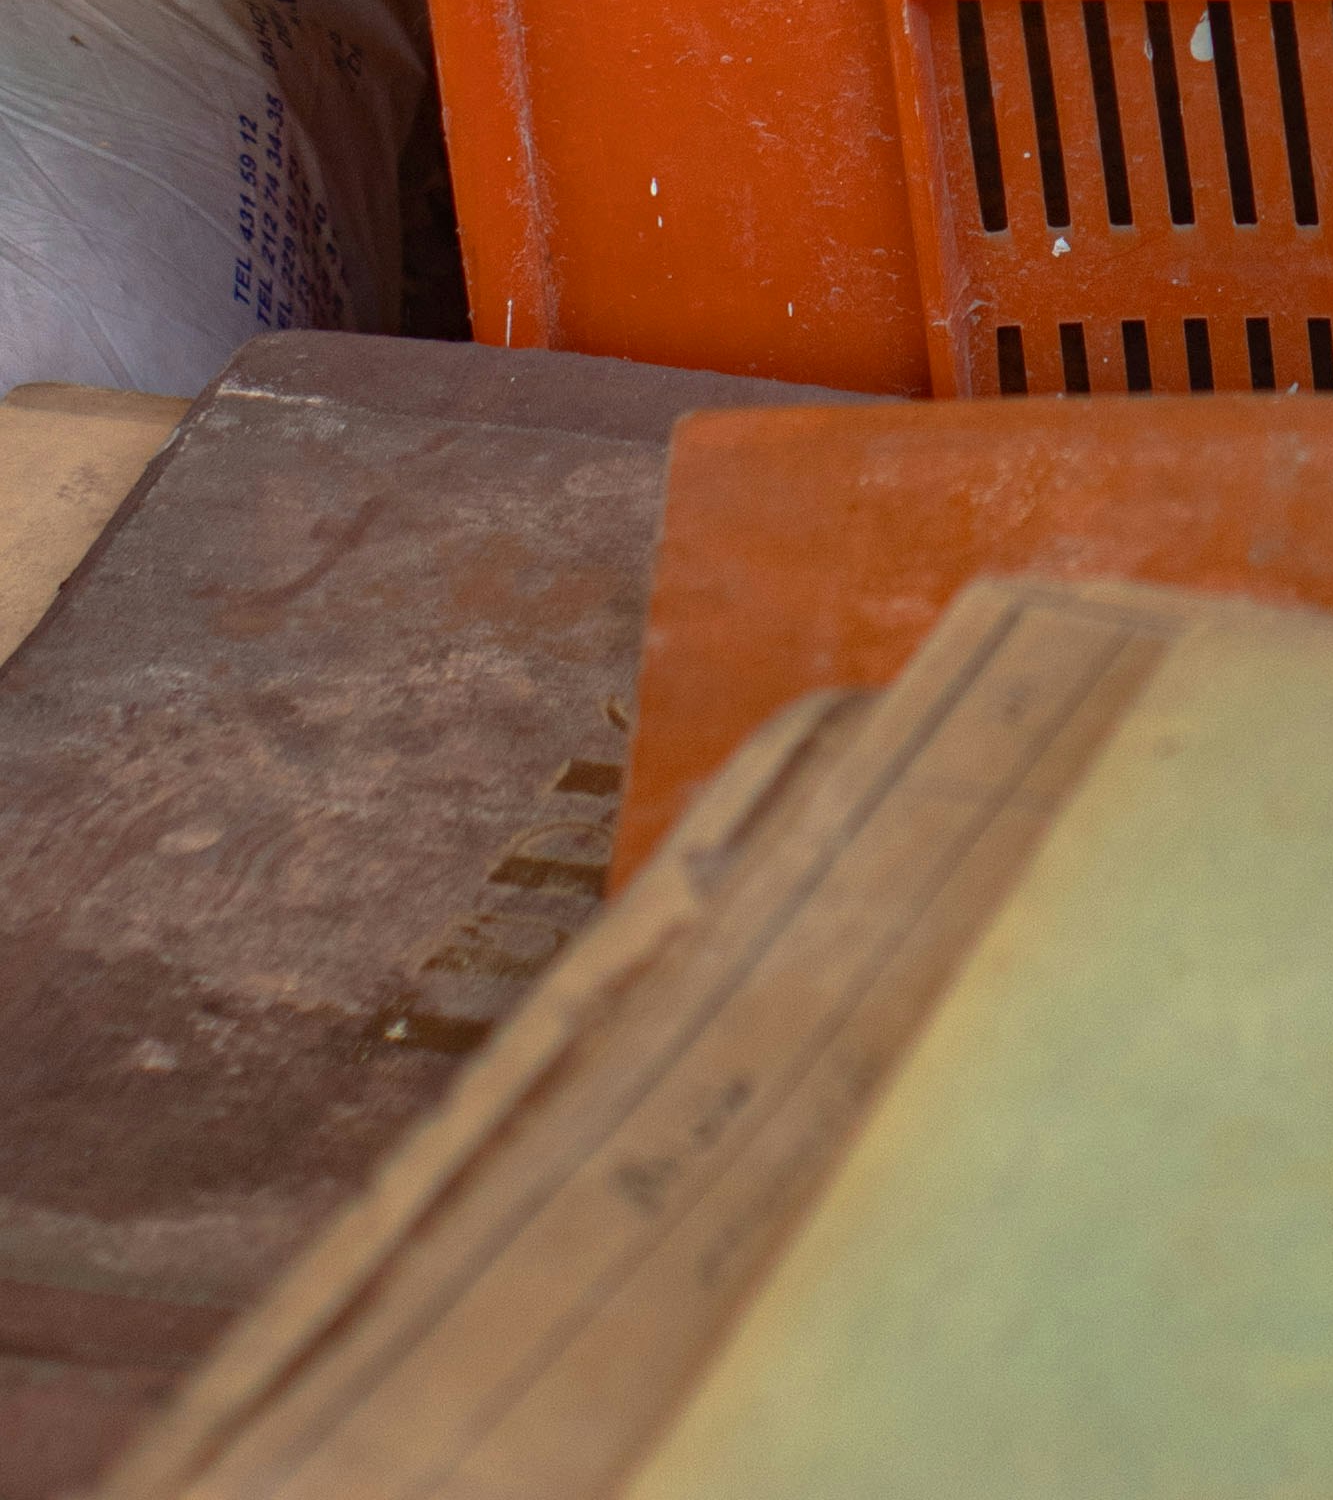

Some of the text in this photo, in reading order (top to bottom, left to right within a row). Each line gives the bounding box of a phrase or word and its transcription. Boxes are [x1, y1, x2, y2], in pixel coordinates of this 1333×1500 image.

[233, 114, 258, 307] TEL 431 59 12
[261, 213, 279, 267] 212
[255, 277, 274, 327] TEL
